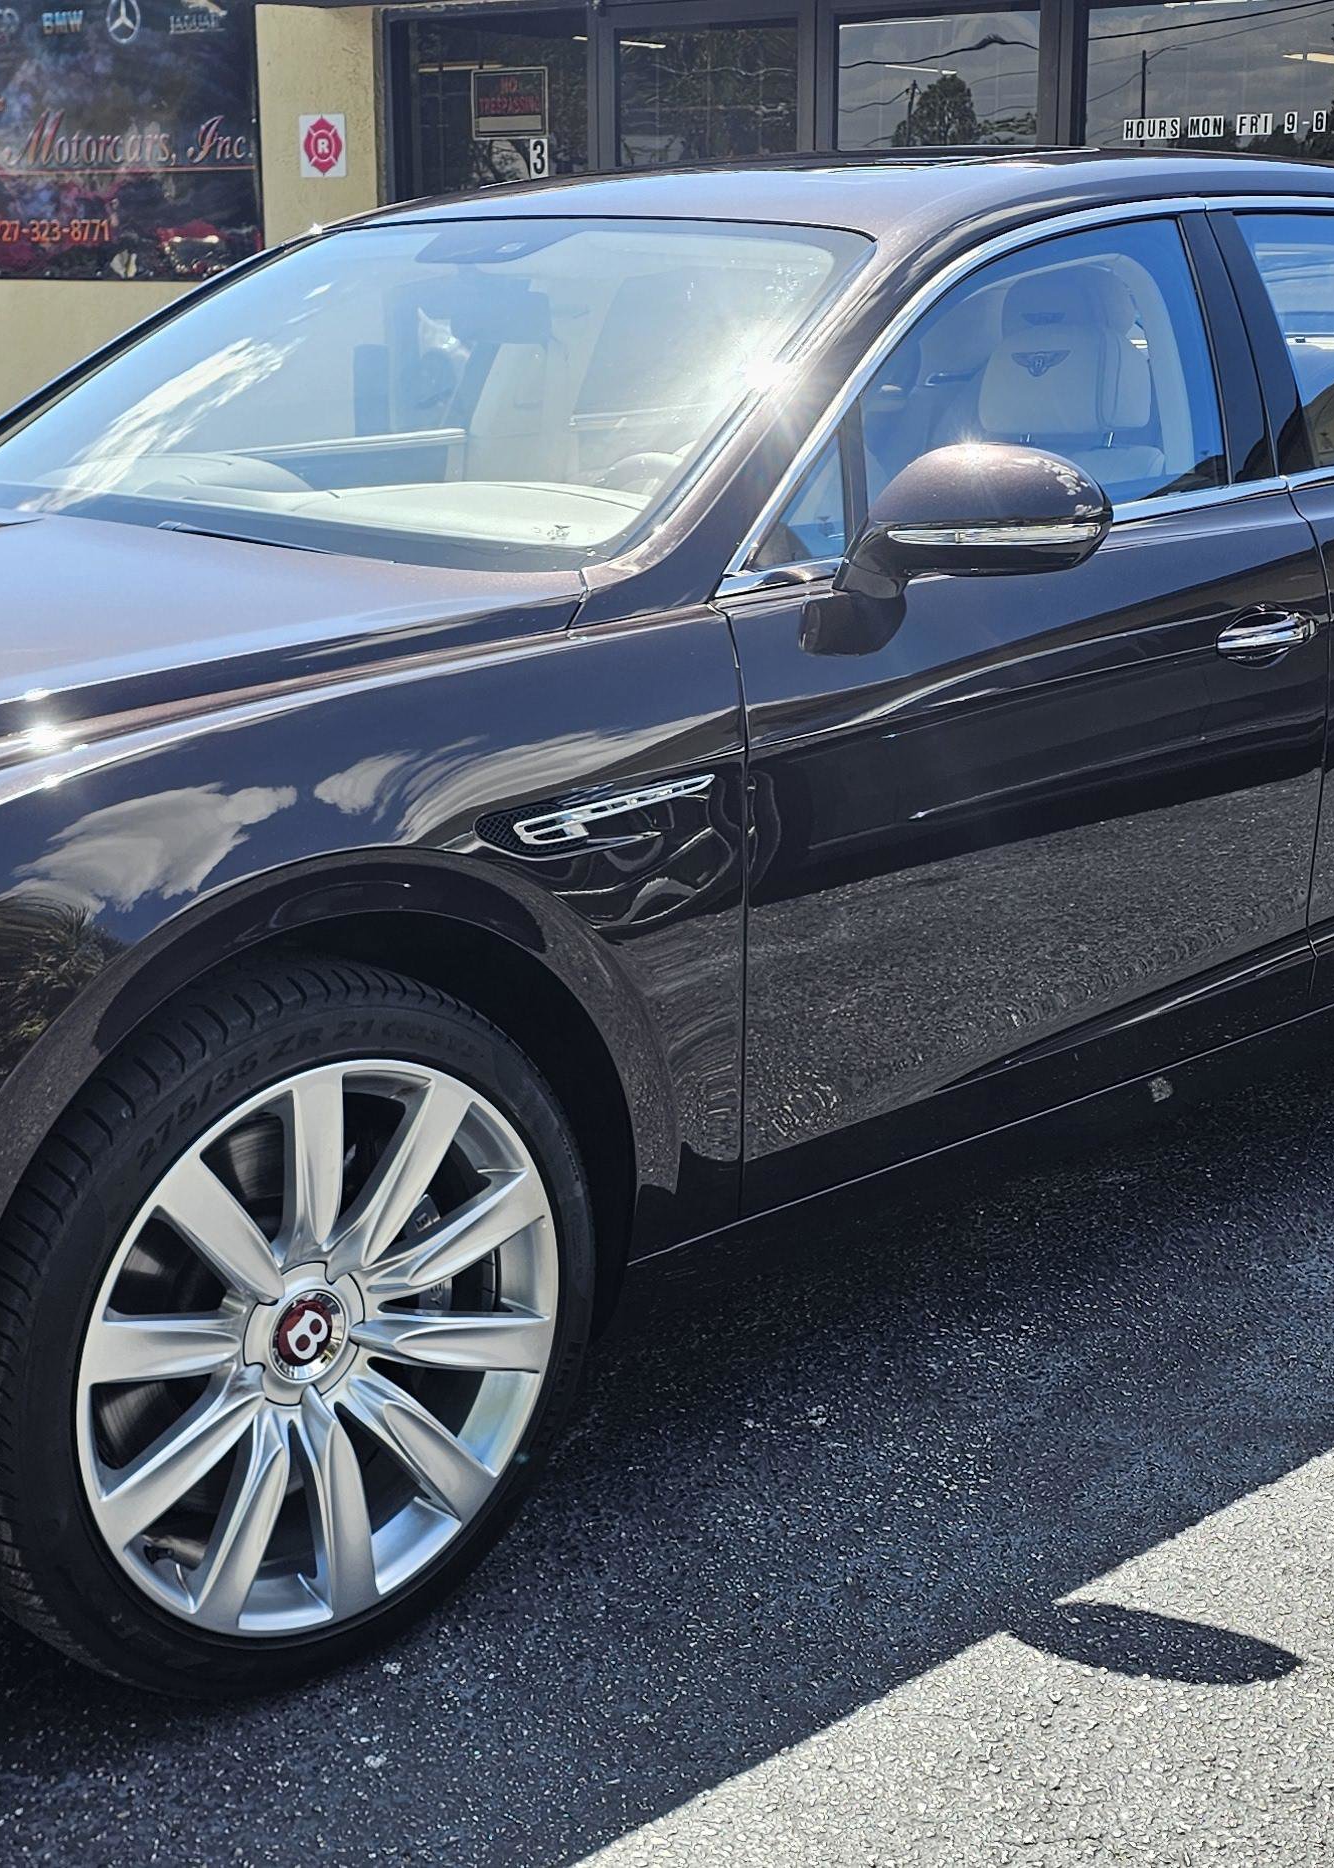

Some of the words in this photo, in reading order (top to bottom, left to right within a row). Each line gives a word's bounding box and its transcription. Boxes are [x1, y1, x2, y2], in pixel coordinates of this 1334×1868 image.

[41, 10, 84, 34] BMW
[500, 76, 518, 93] NO
[3, 107, 176, 166] Motorcars,
[187, 115, 254, 163] Inc.
[1125, 118, 1179, 139] HOURS
[1188, 116, 1223, 138] MON
[1238, 113, 1269, 135] FRI
[317, 138, 331, 154] R
[533, 140, 545, 174] 3
[266, 1026, 324, 1063] ZR
[332, 1018, 376, 1040] 21
